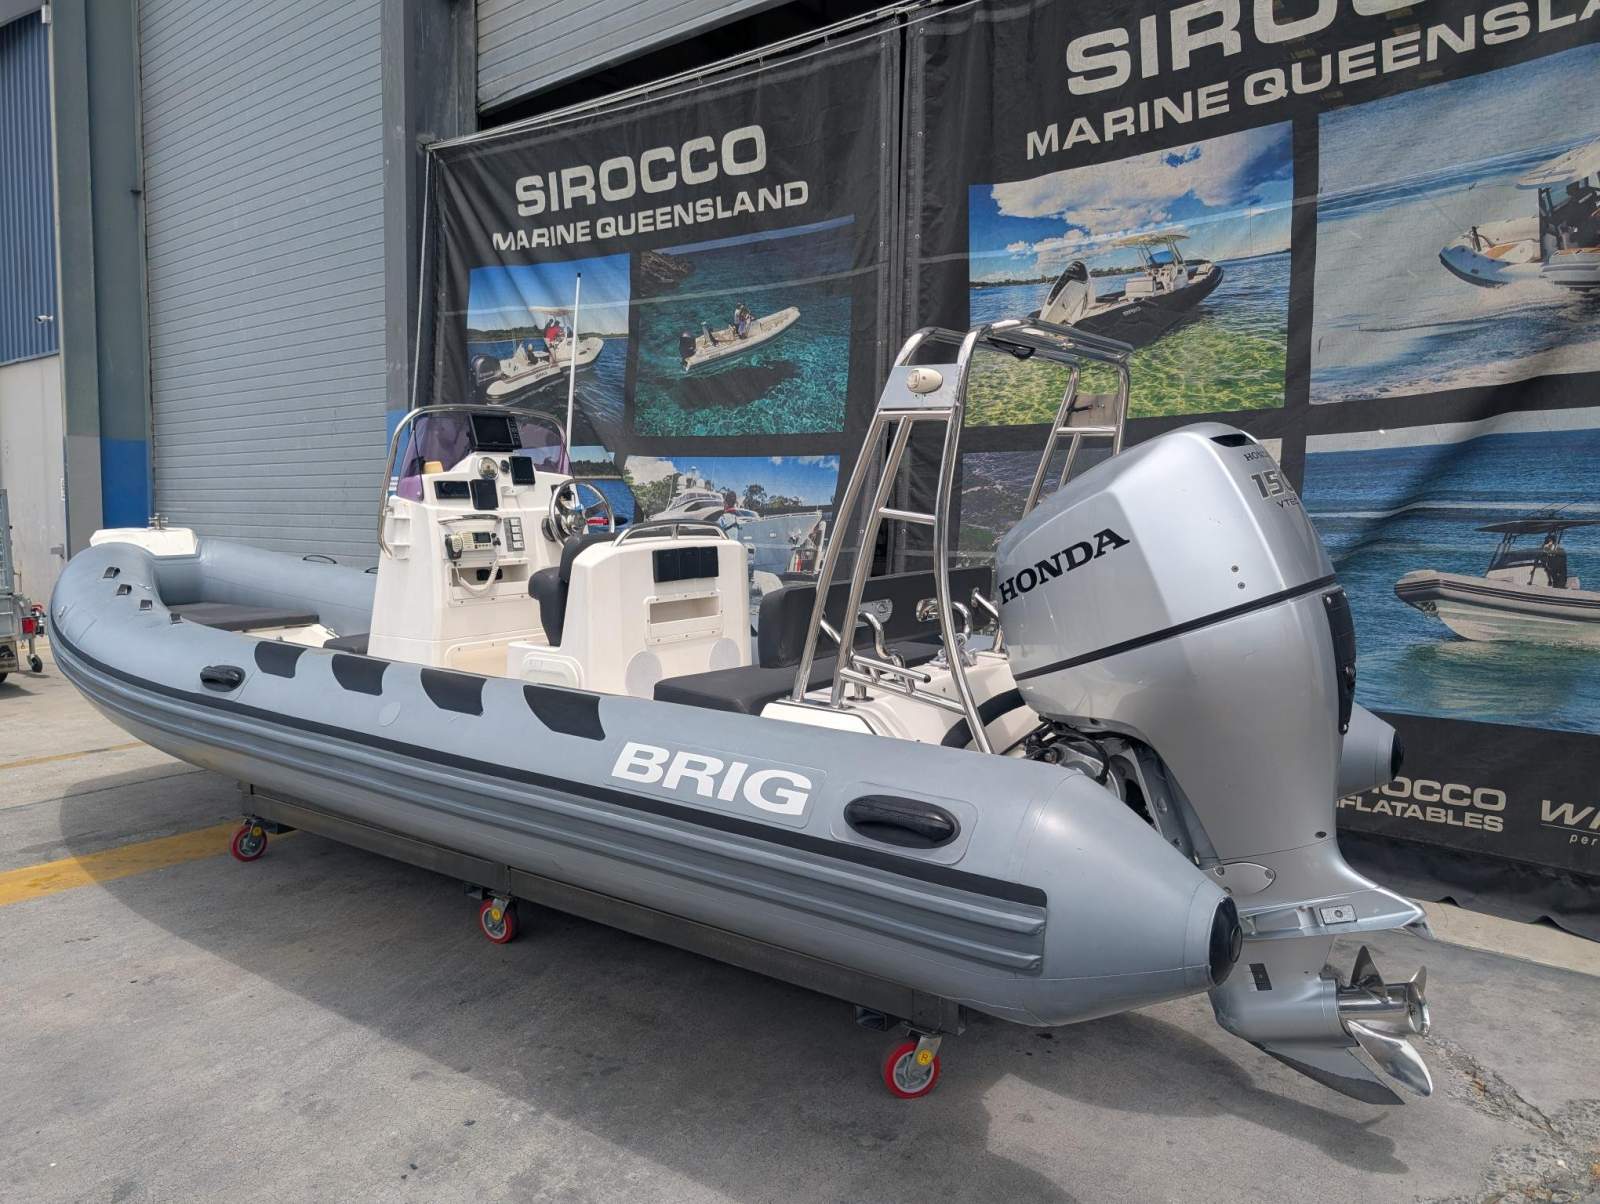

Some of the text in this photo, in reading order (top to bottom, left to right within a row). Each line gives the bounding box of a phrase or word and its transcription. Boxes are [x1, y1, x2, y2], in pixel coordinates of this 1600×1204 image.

[1027, 80, 1230, 160] MARINE
[515, 125, 767, 217] SIROCCO
[492, 181, 808, 251] MARINE QUEENSLAND
[999, 528, 1130, 605] HONDA
[611, 742, 812, 816] BRIG
[1336, 796, 1504, 833] FLATABLES
[1372, 776, 1506, 812] OCCO
